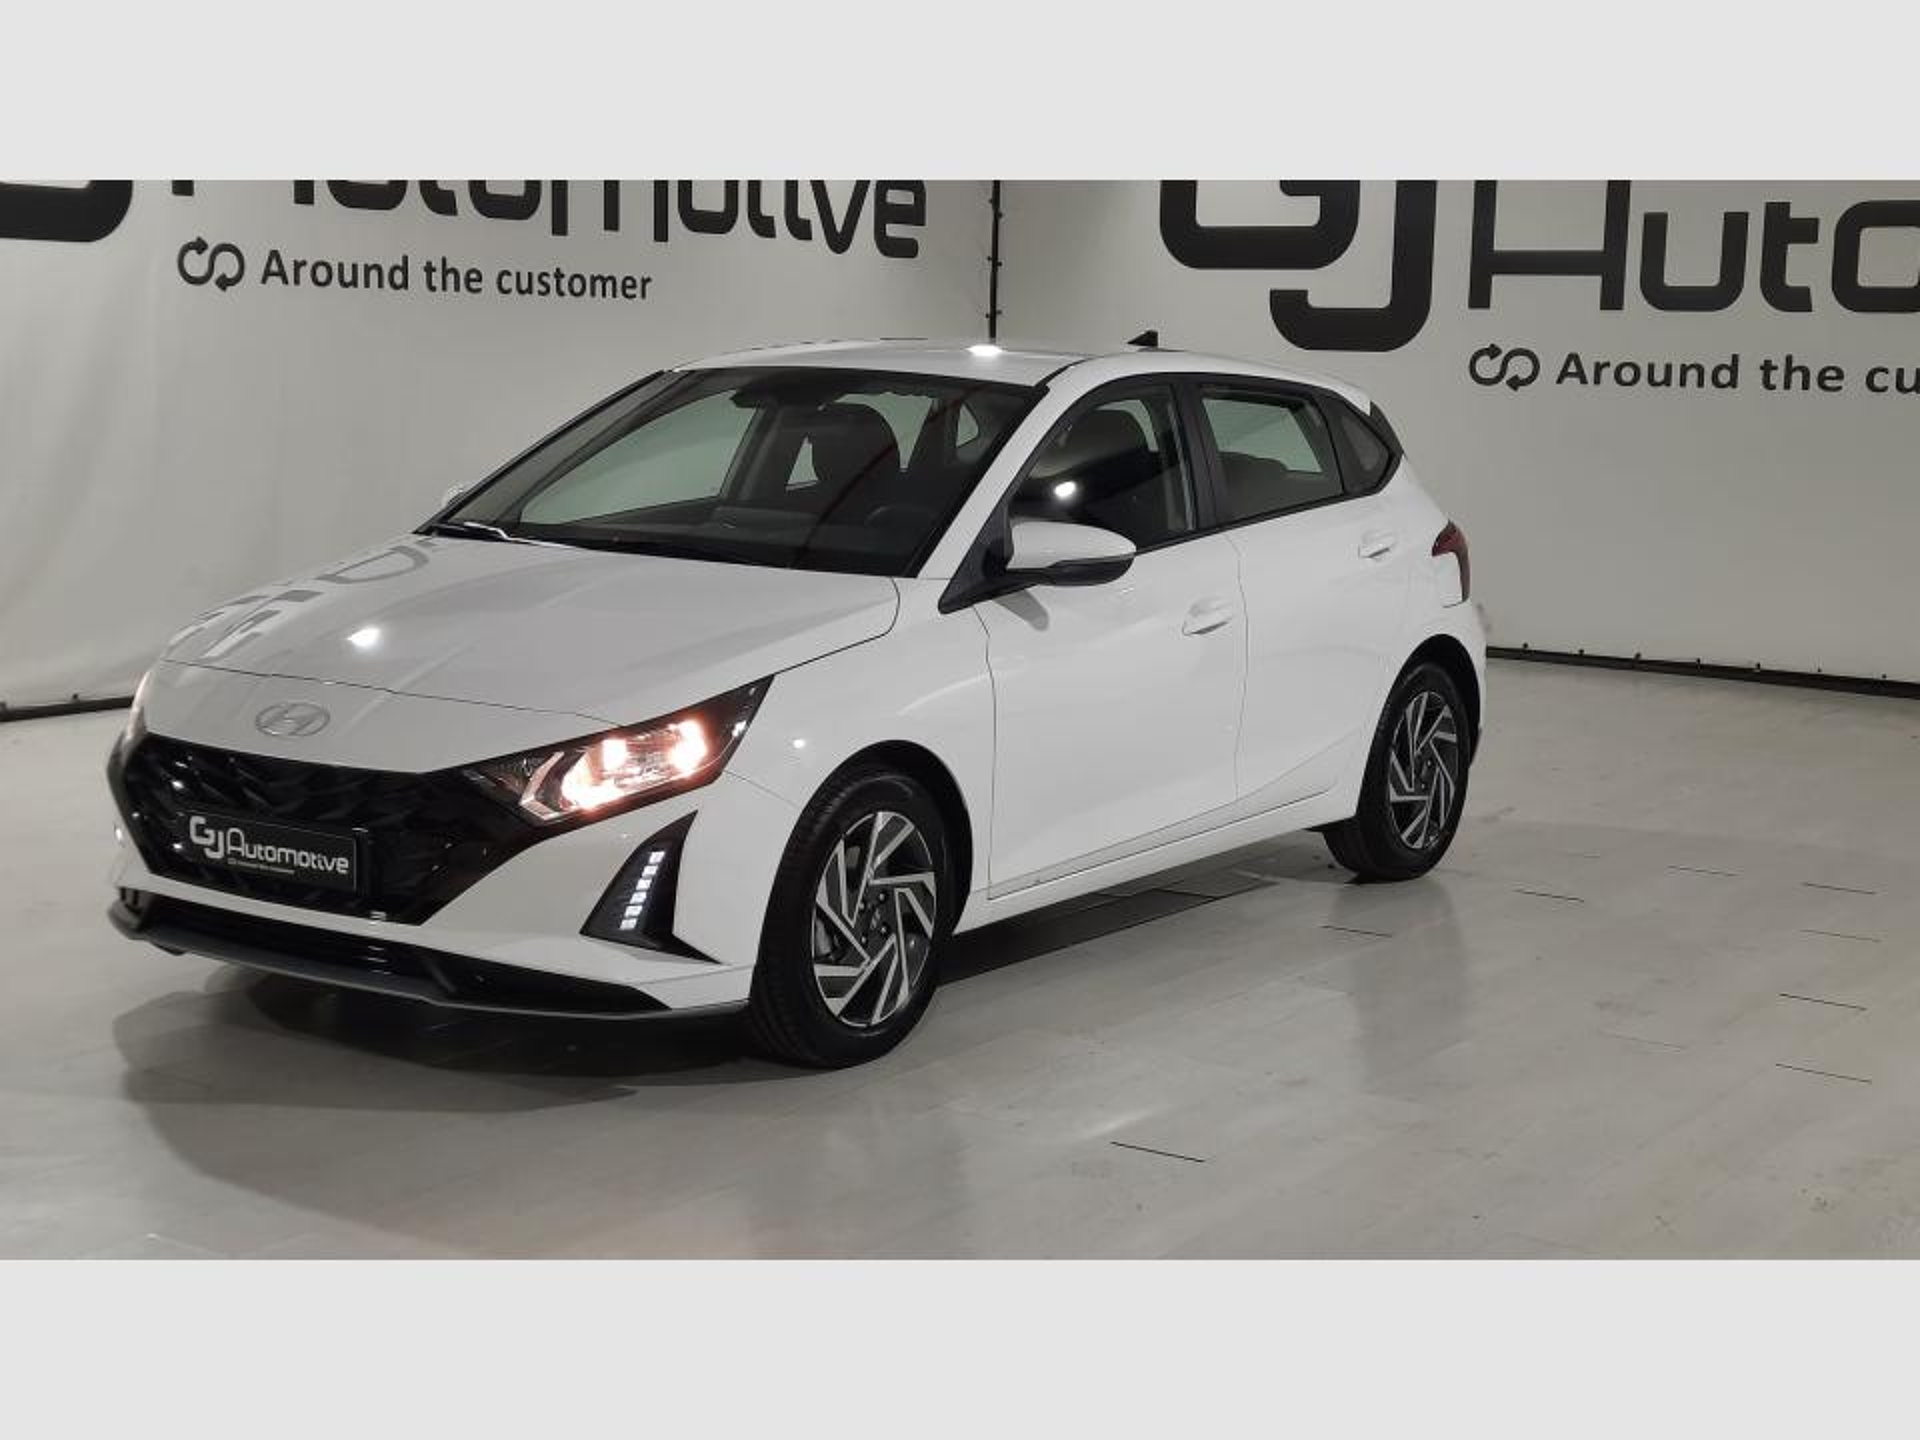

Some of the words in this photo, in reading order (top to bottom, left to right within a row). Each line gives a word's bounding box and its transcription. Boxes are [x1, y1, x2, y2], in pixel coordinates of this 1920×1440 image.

[260, 249, 409, 291] Around
[423, 256, 483, 294] the
[495, 267, 652, 301] customer
[1555, 352, 1740, 389] Around
[1759, 353, 1845, 393] the
[1865, 366, 1920, 395] cu
[226, 827, 350, 875] Automotive
